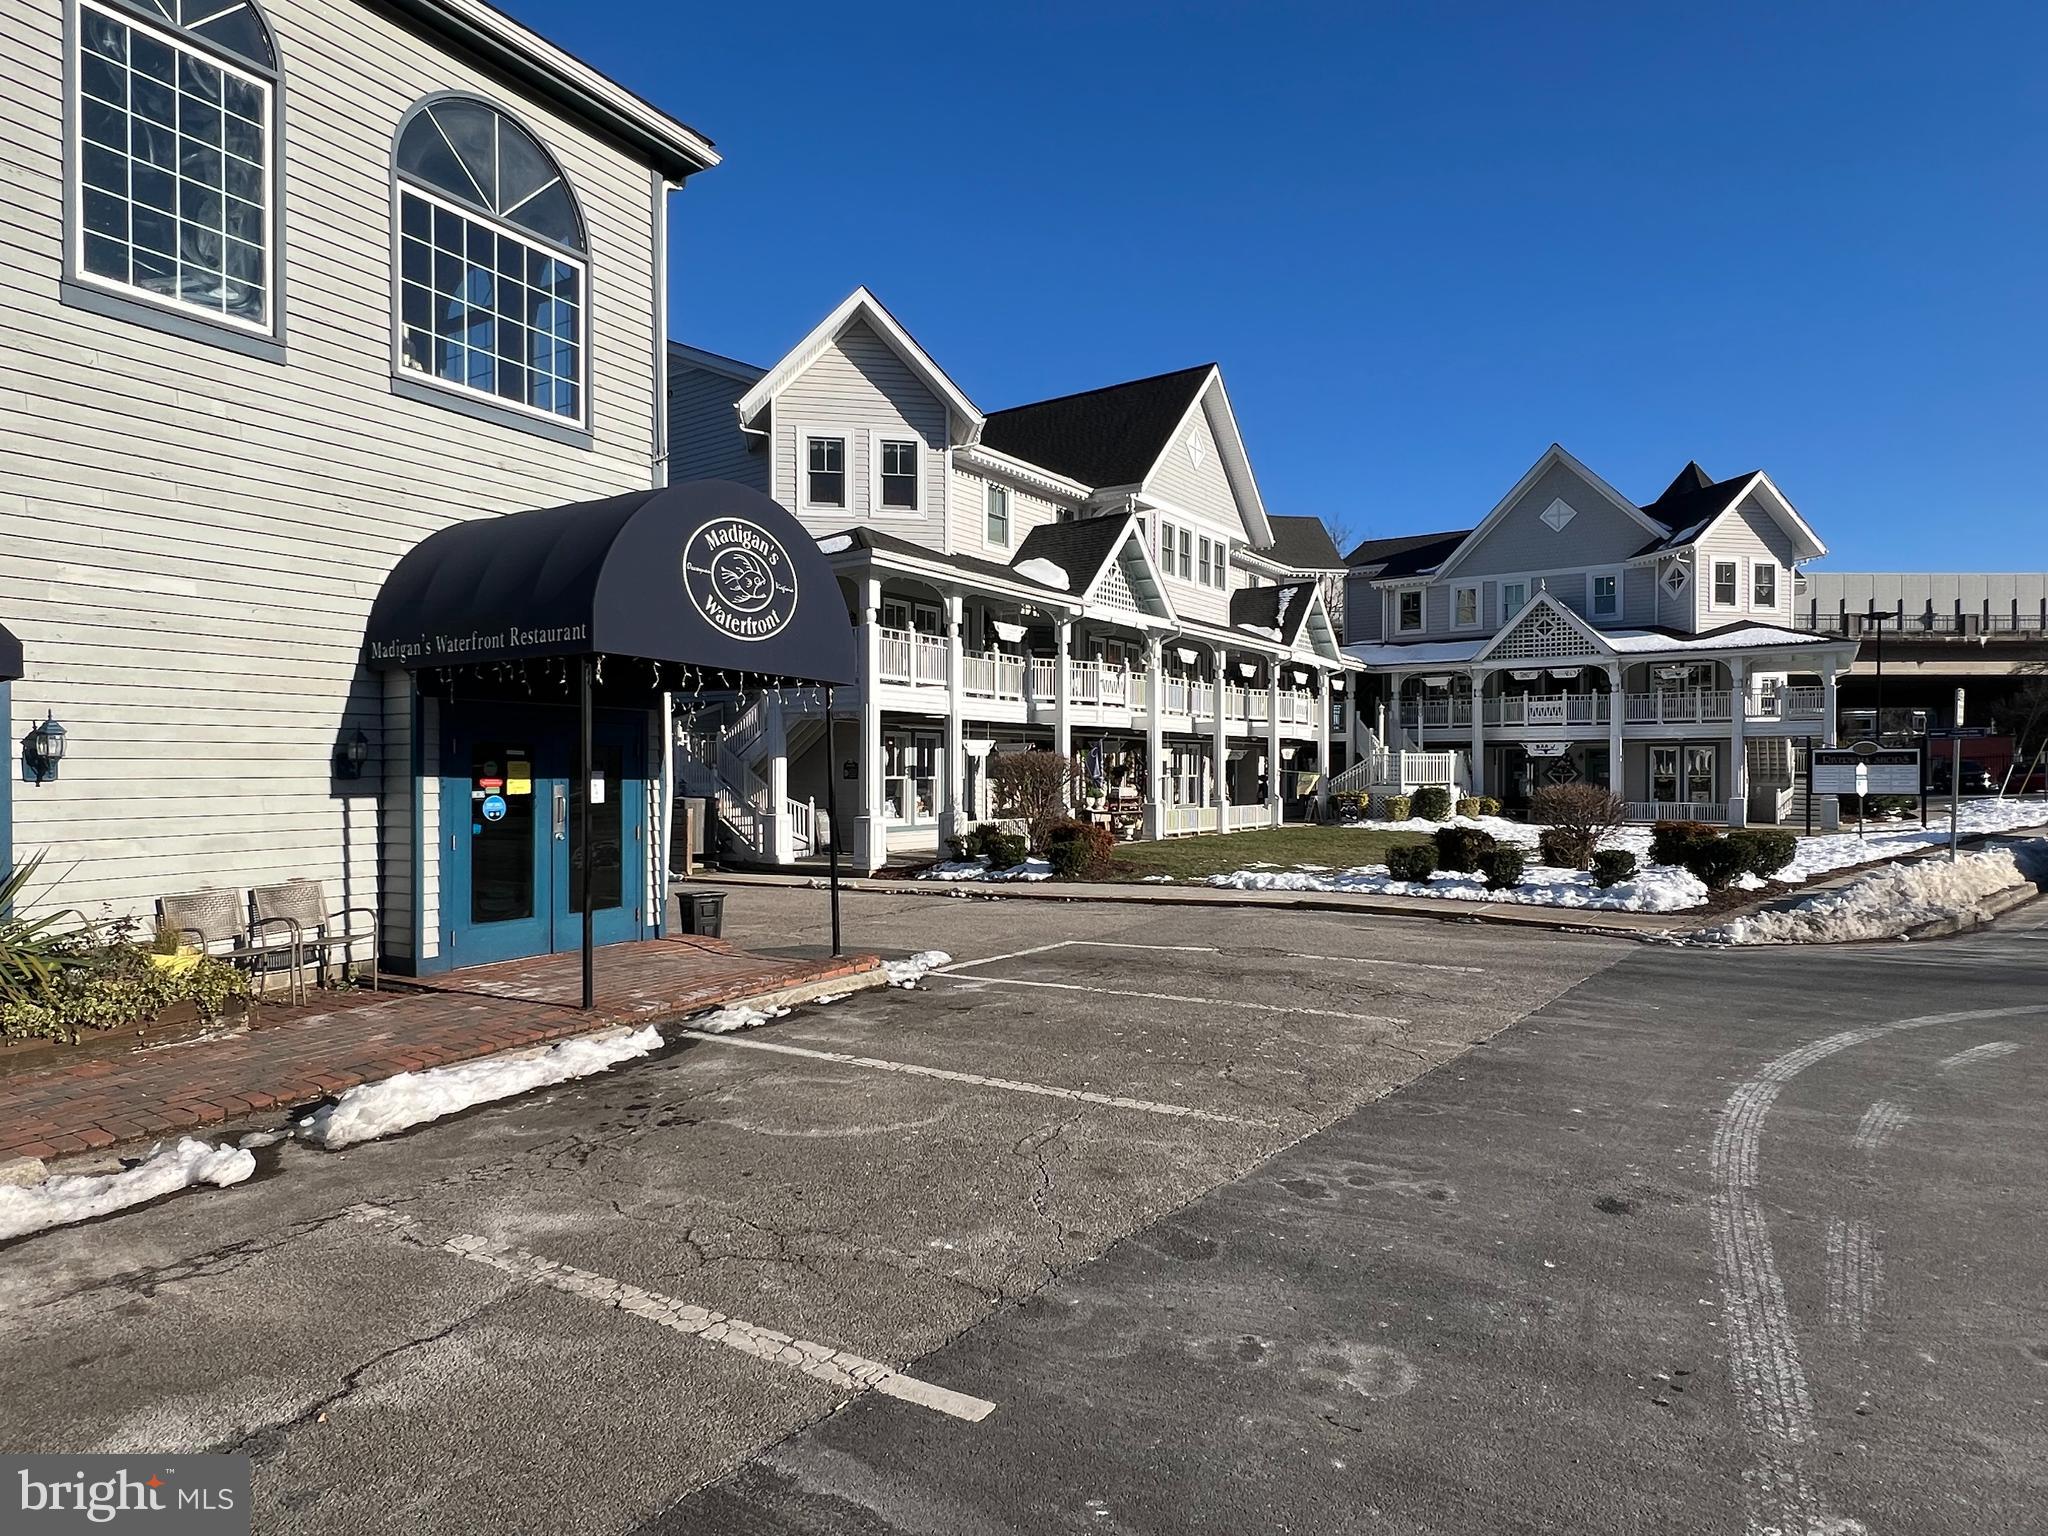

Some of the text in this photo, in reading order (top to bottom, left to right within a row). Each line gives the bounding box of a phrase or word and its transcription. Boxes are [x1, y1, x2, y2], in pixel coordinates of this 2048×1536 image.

[704, 524, 780, 566] Madigan's
[704, 594, 781, 635] Waterfront
[371, 623, 587, 664] Madigan's Waterfront Restaurant
